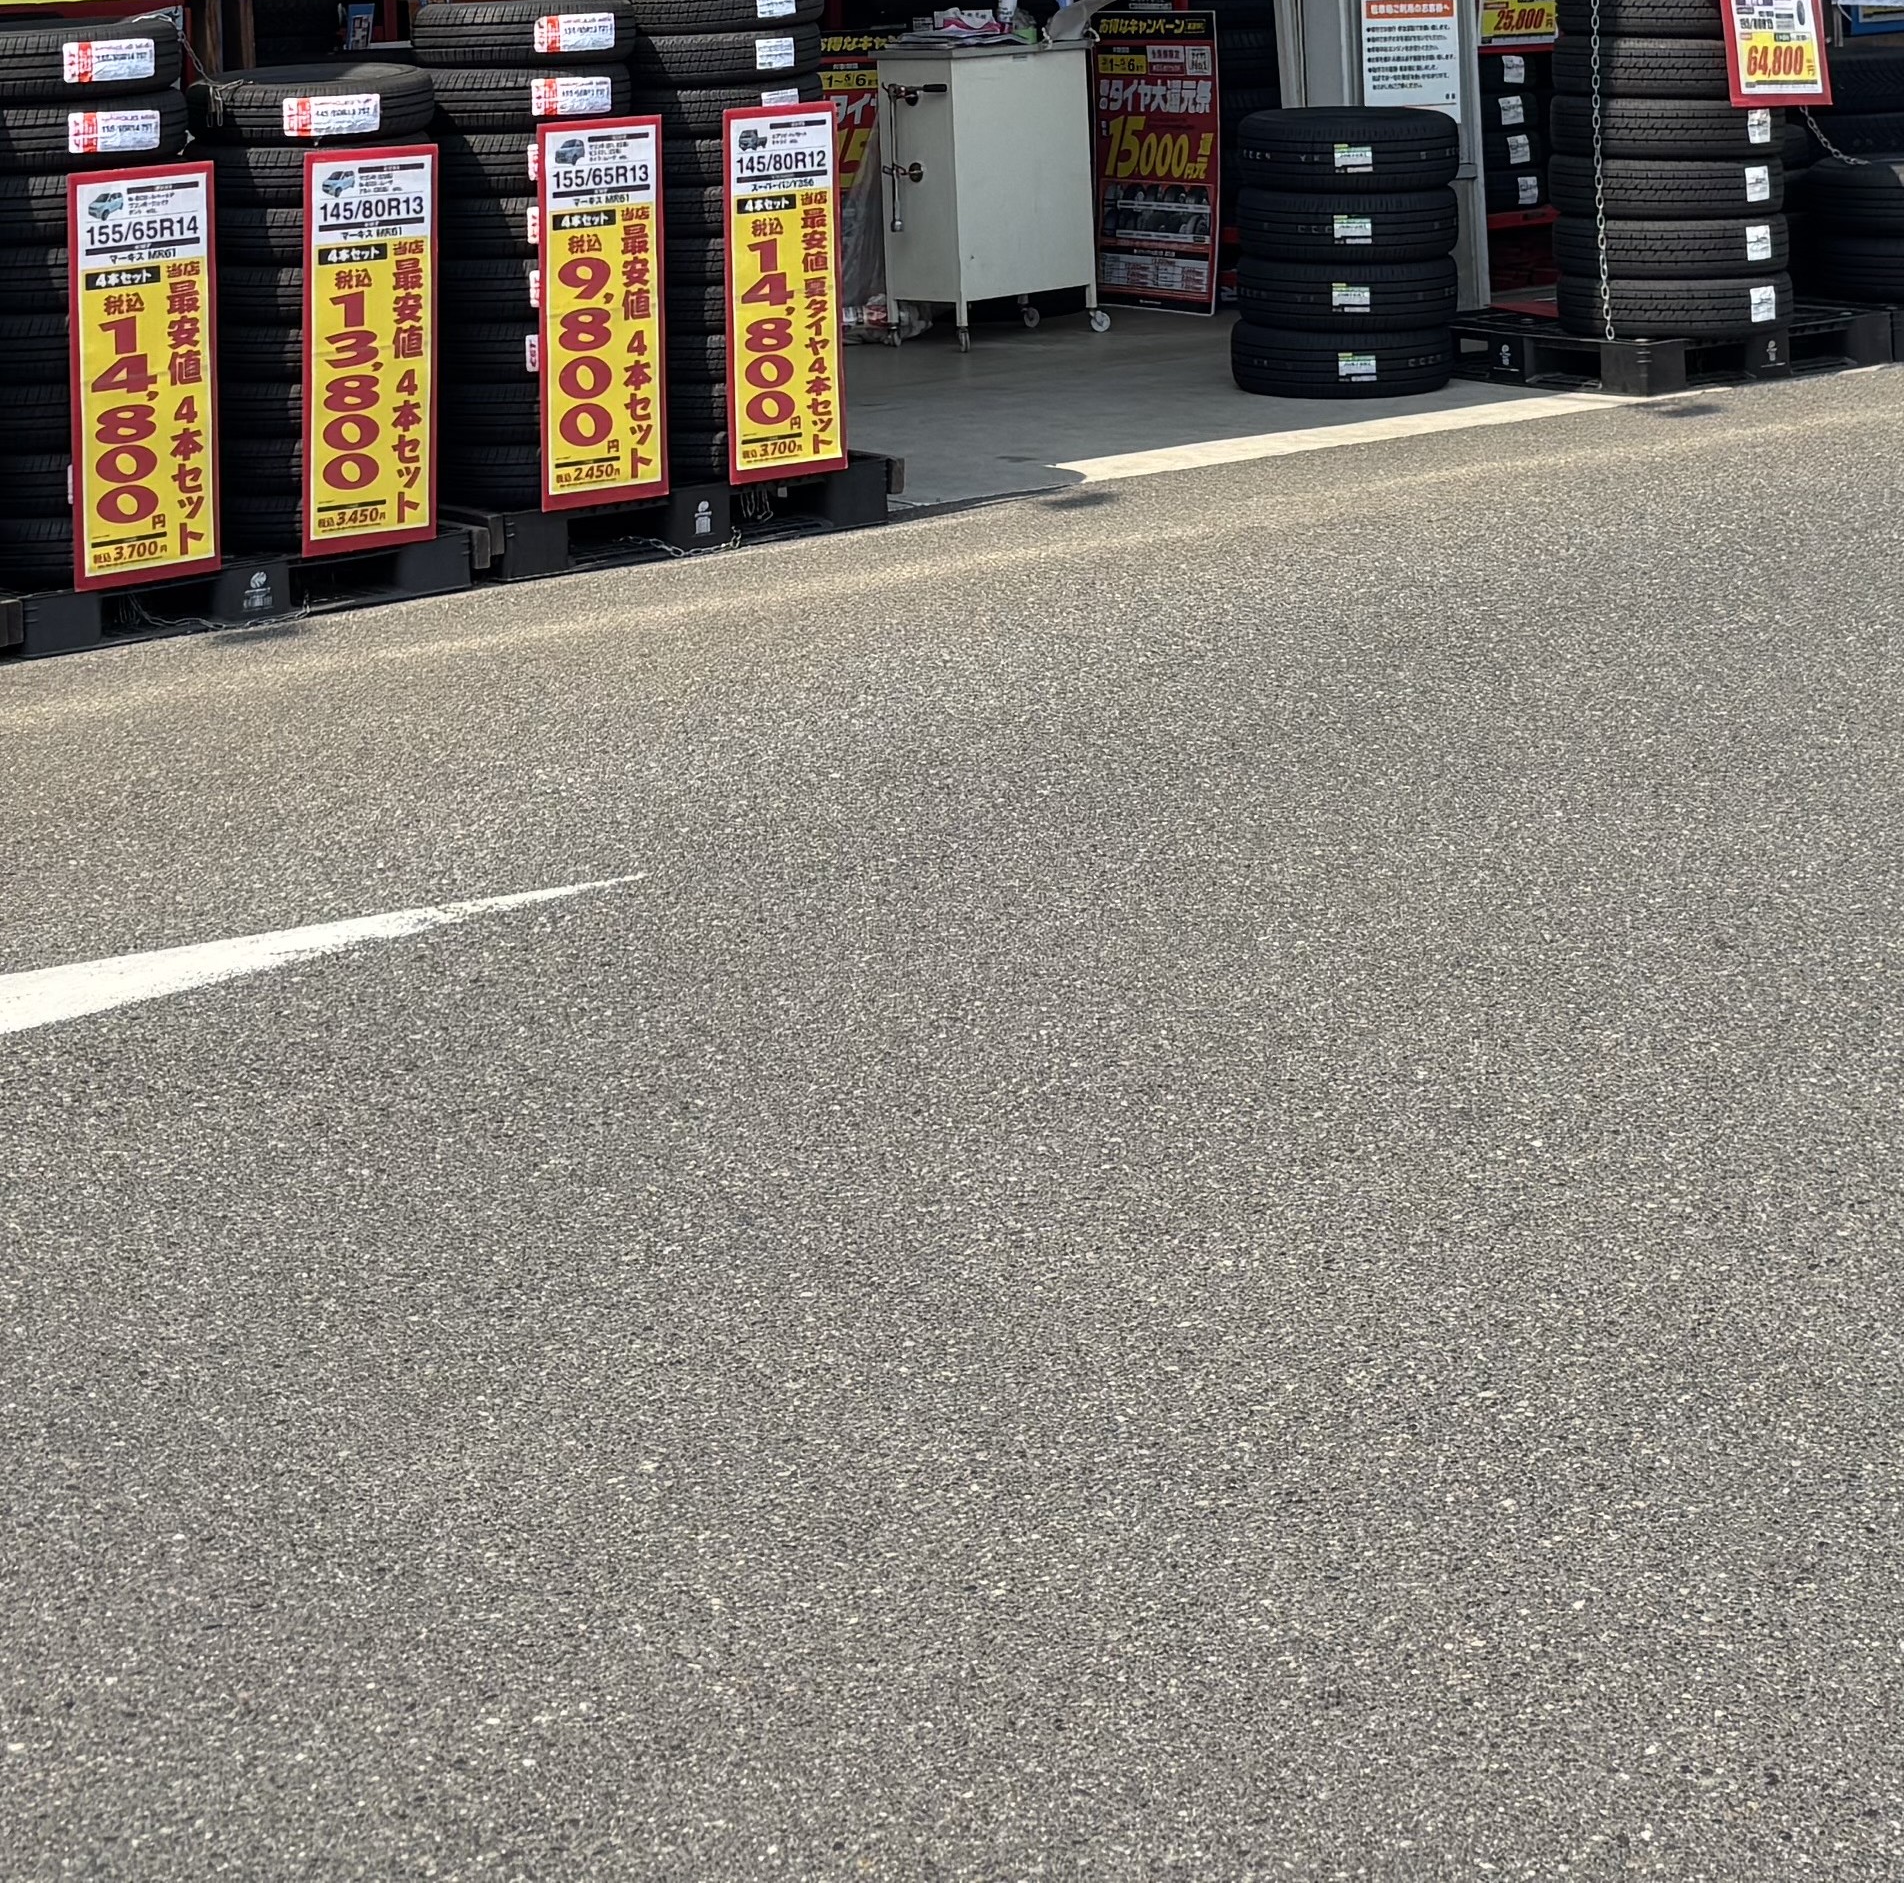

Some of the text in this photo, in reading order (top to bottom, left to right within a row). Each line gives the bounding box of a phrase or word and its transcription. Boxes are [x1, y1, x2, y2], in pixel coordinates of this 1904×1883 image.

[552, 163, 650, 190] 155/65R13
[736, 149, 827, 174] 145/80R12
[319, 197, 424, 222] 145/80R13
[85, 215, 199, 246] 155/65R14
[620, 223, 653, 478] 最安値 4本セット
[391, 259, 424, 523] 最安値 4本セット
[166, 282, 206, 556] 最安値 4本セット
